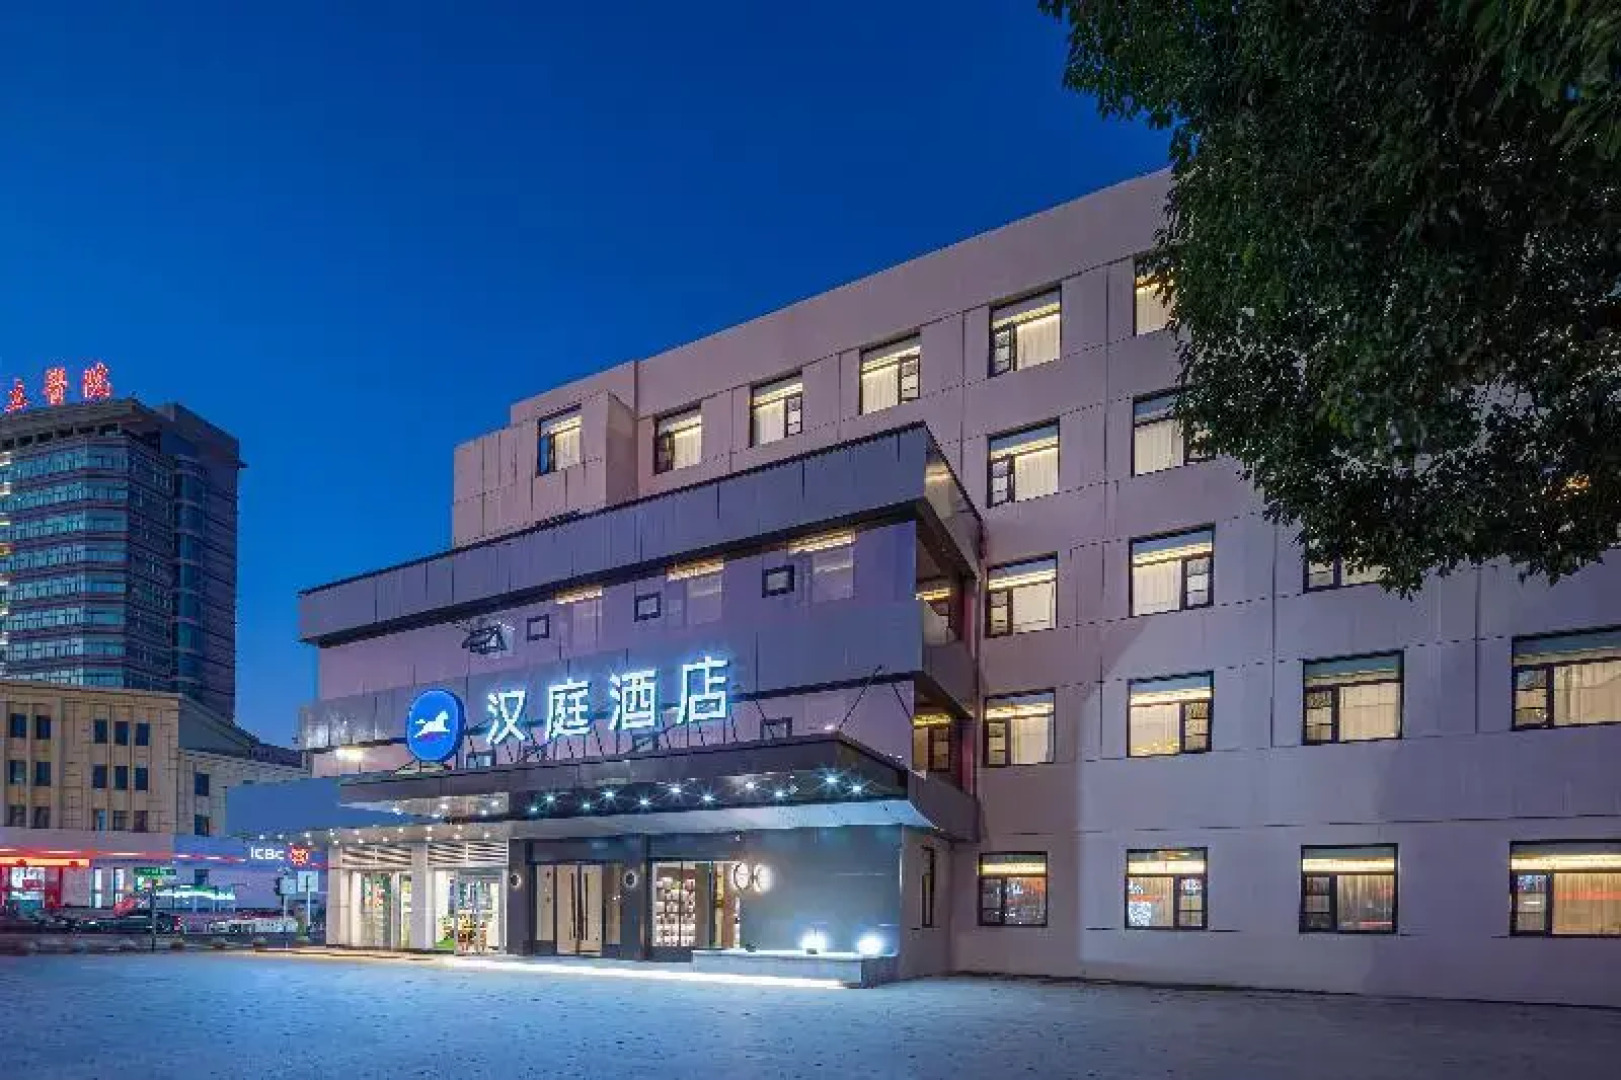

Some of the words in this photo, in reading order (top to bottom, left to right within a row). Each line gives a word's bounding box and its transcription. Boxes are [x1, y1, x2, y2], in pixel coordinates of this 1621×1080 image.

[486, 656, 729, 745] 汉庭酒店
[250, 847, 285, 860] ICBC
